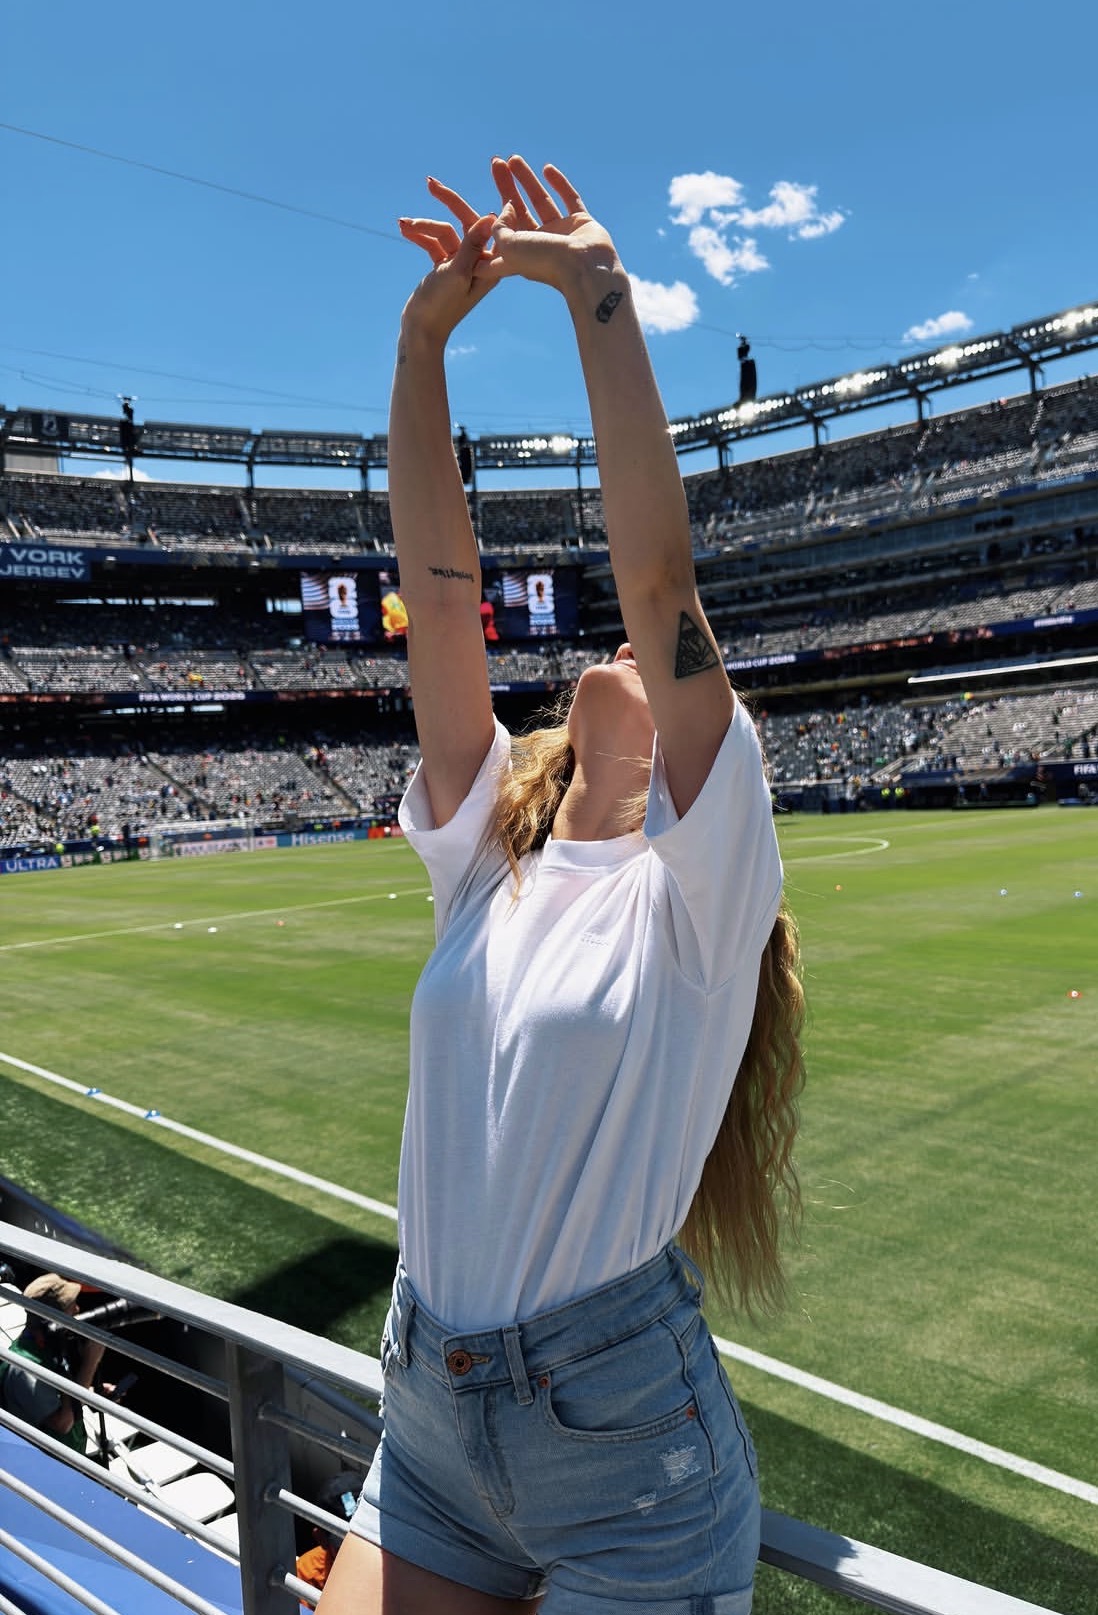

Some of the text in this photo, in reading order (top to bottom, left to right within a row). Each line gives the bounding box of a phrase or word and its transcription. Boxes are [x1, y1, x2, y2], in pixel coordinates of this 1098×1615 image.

[9, 548, 84, 565] YORK
[0, 564, 85, 578] JERSEY
[726, 660, 752, 670] WORLD
[752, 657, 768, 667] CUP
[139, 692, 160, 701] FIFA
[161, 691, 193, 701] WORLD
[194, 691, 212, 701] CUP
[1073, 763, 1097, 776] FIFA
[291, 828, 355, 846] Hisense
[5, 856, 58, 872] ULTRA
